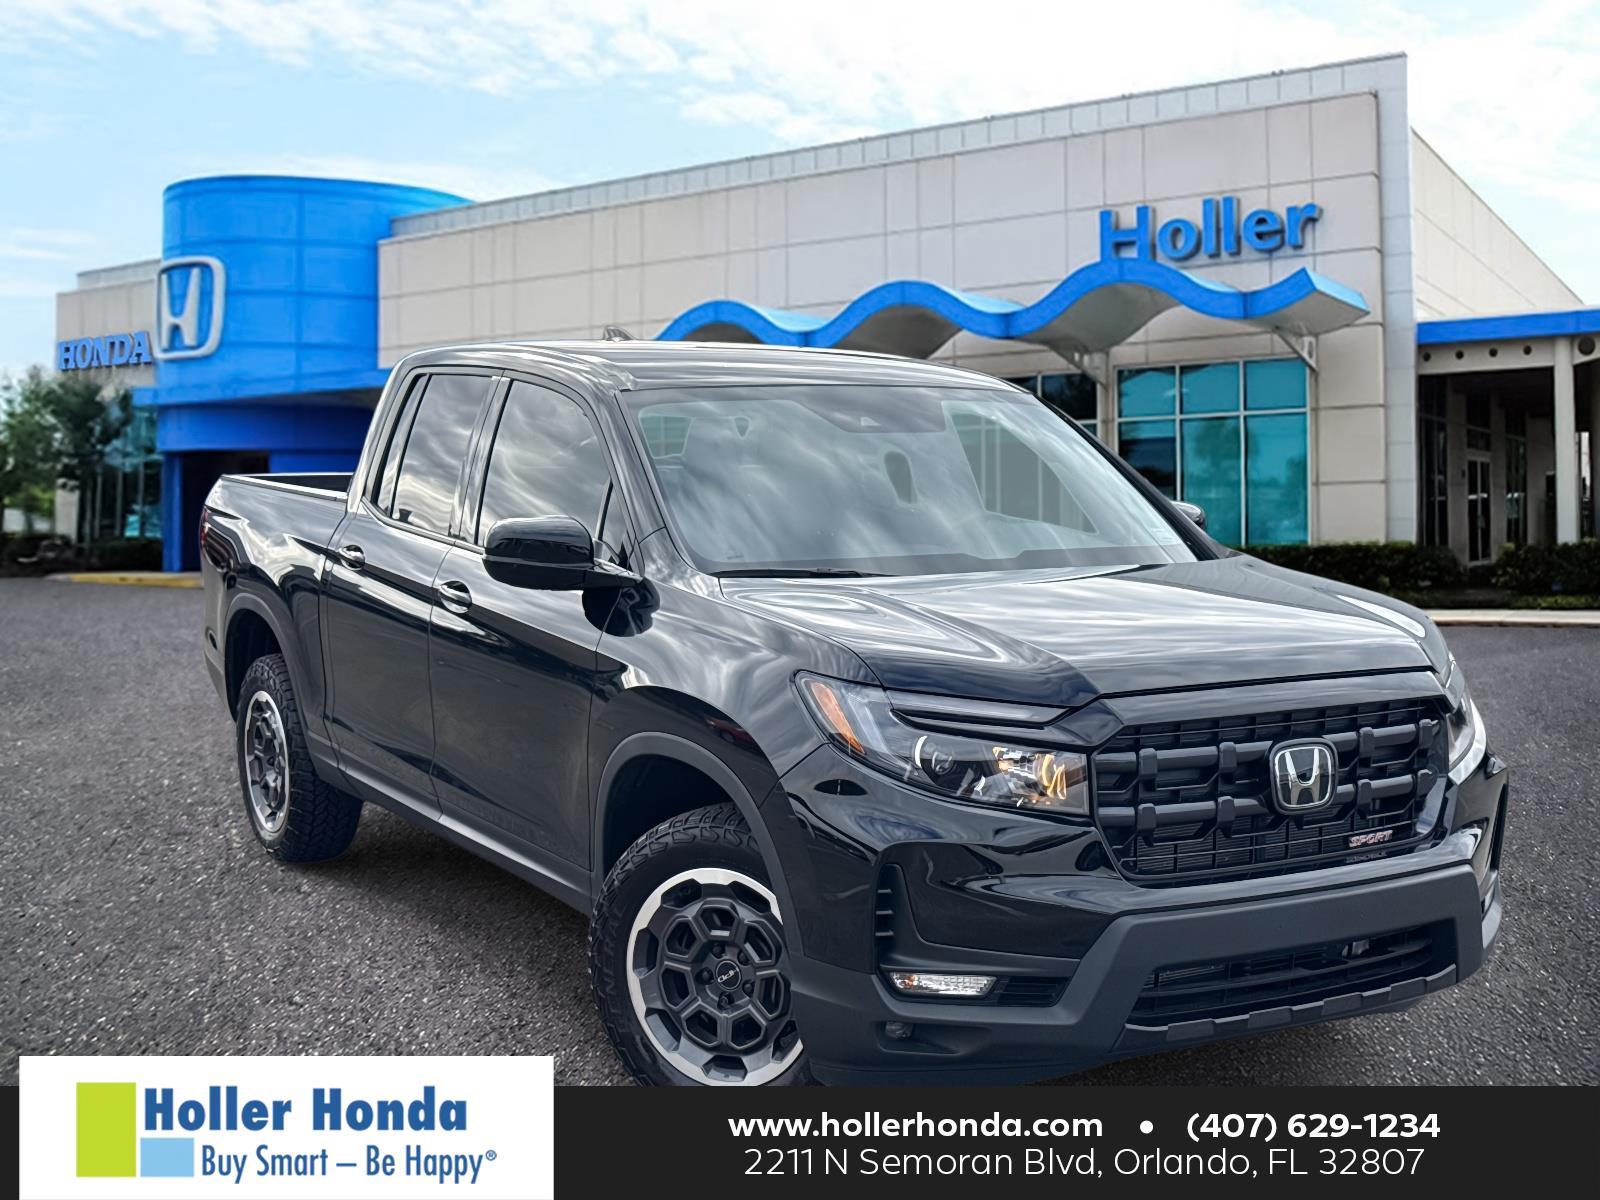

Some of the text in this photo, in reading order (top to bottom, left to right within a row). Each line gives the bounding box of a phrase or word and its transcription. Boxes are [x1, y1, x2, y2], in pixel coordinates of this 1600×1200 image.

[1099, 196, 1322, 262] Holler
[58, 331, 152, 370] HONDA
[1348, 829, 1394, 848] SPORT
